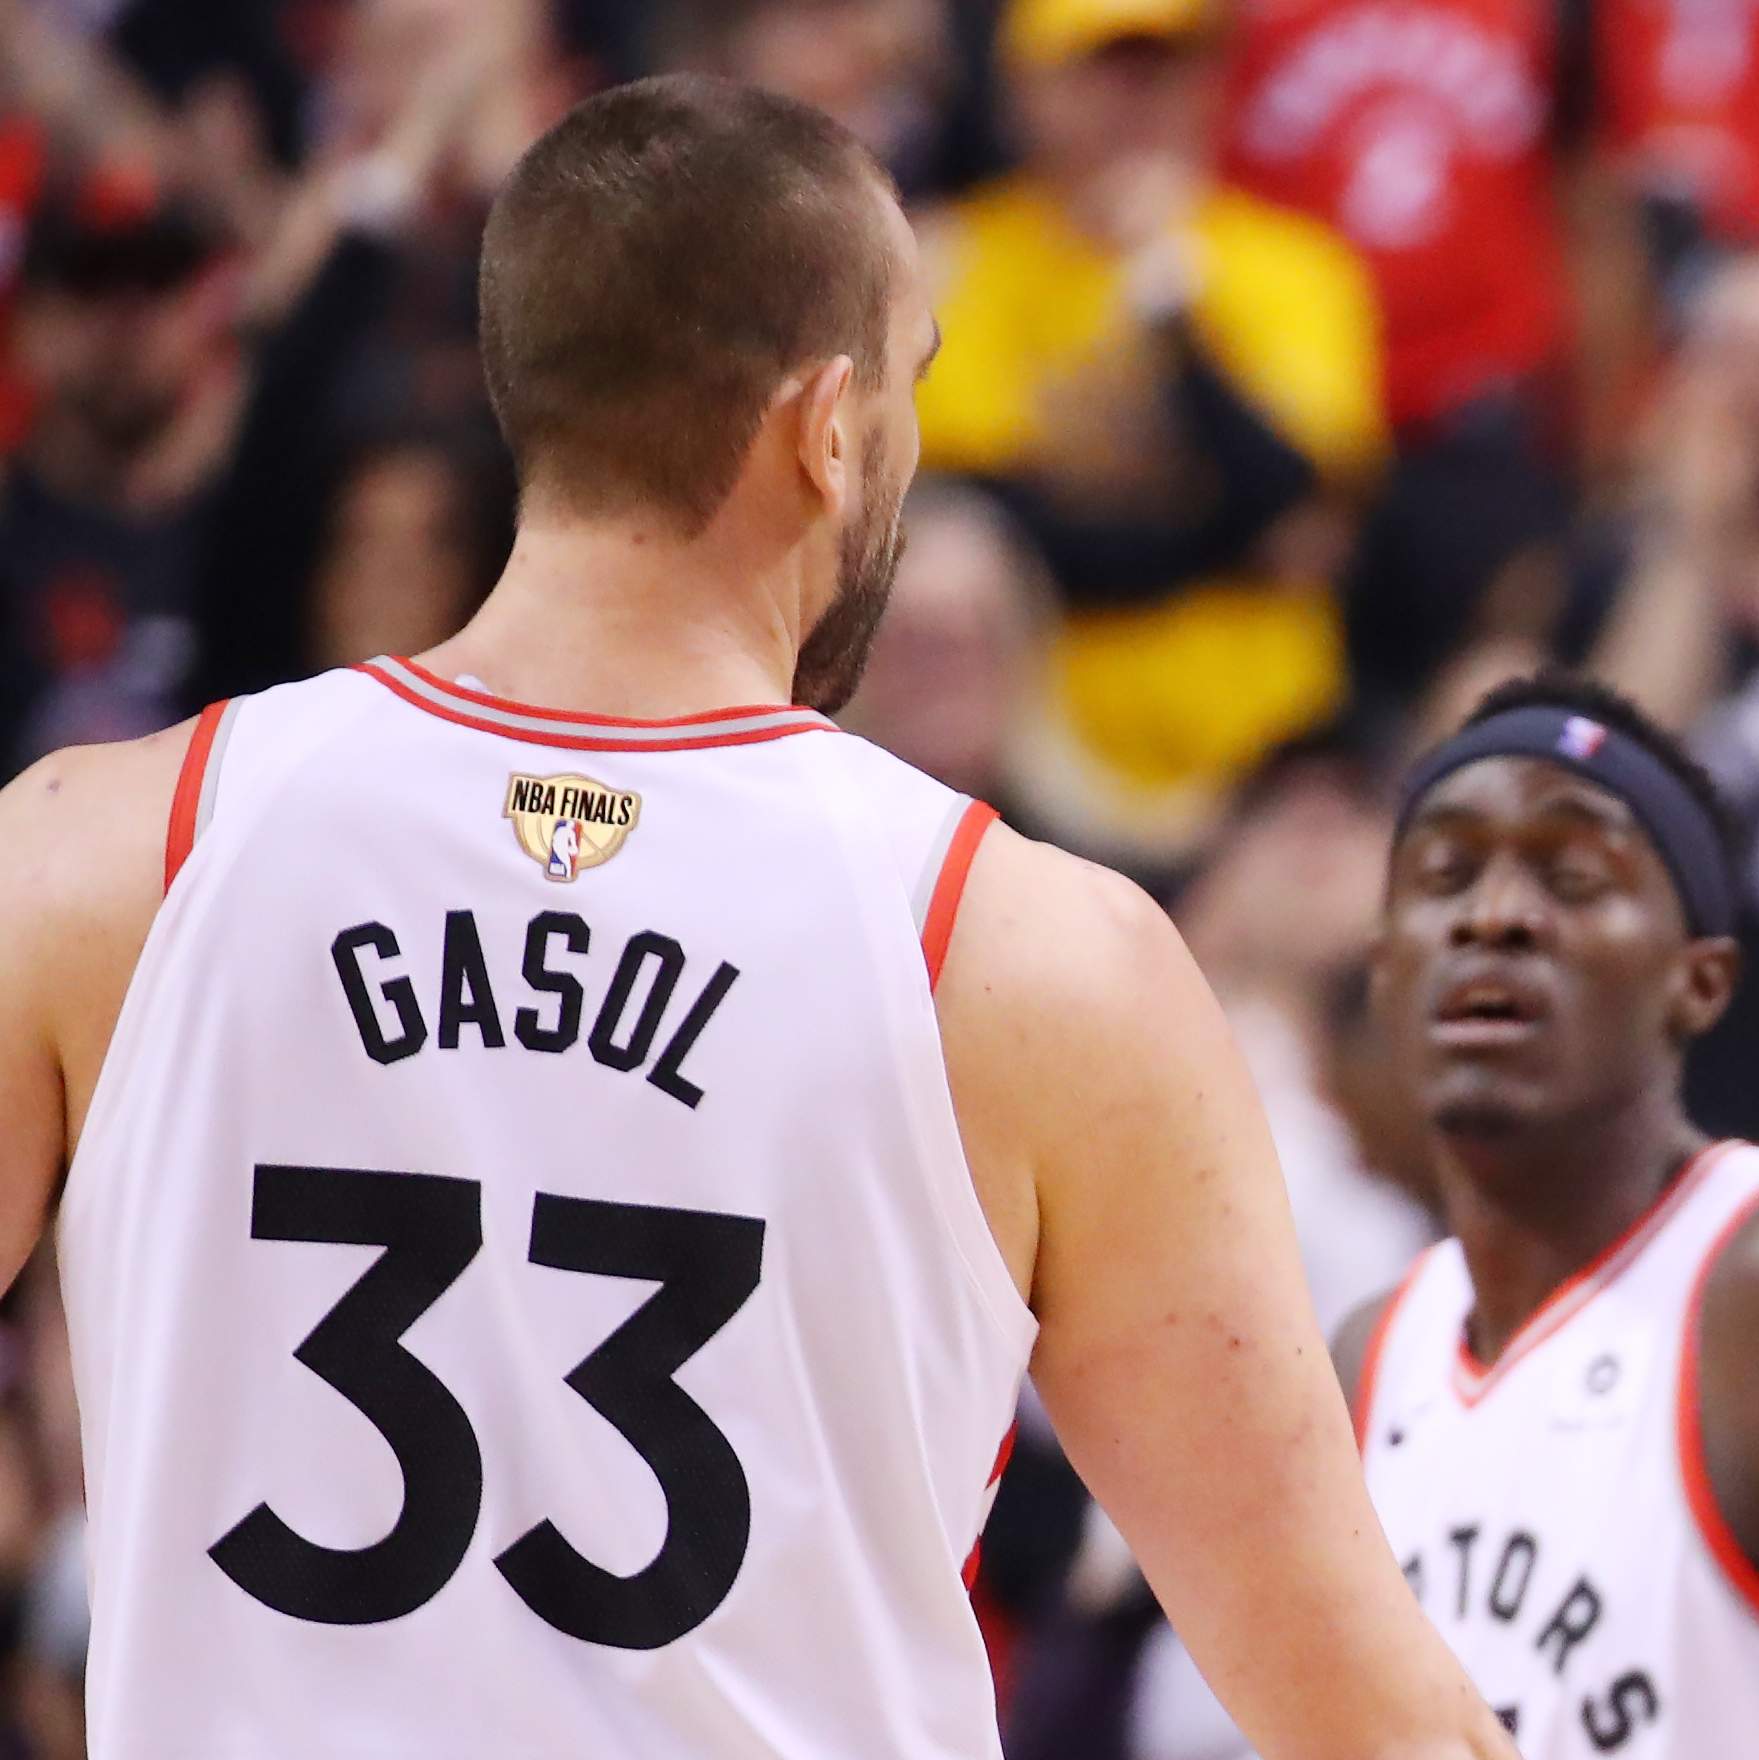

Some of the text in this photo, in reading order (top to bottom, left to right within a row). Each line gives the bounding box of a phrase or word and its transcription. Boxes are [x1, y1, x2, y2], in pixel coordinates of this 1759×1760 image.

[512, 779, 632, 826] NBA FINALS
[331, 910, 740, 1110] GASOL
[207, 1164, 766, 1650] 33
